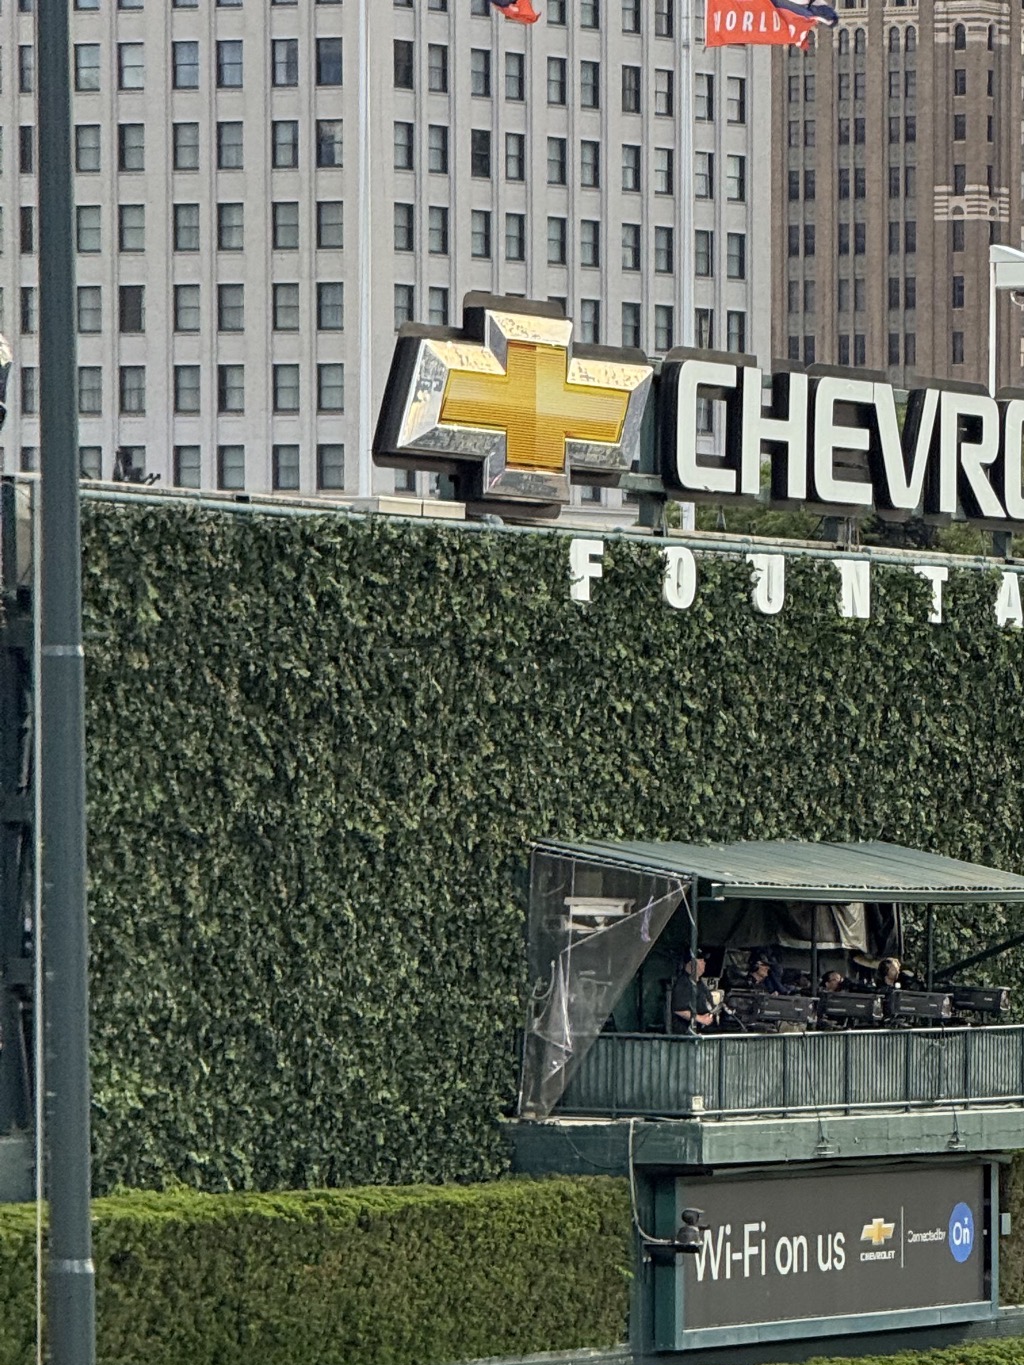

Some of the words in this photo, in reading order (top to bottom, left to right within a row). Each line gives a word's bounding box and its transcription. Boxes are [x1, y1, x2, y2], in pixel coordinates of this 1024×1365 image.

[694, 1220, 767, 1282] Wi-Fi
[775, 1235, 808, 1275] on
[817, 1231, 846, 1272] us
[860, 1250, 895, 1262] CHEVROLET
